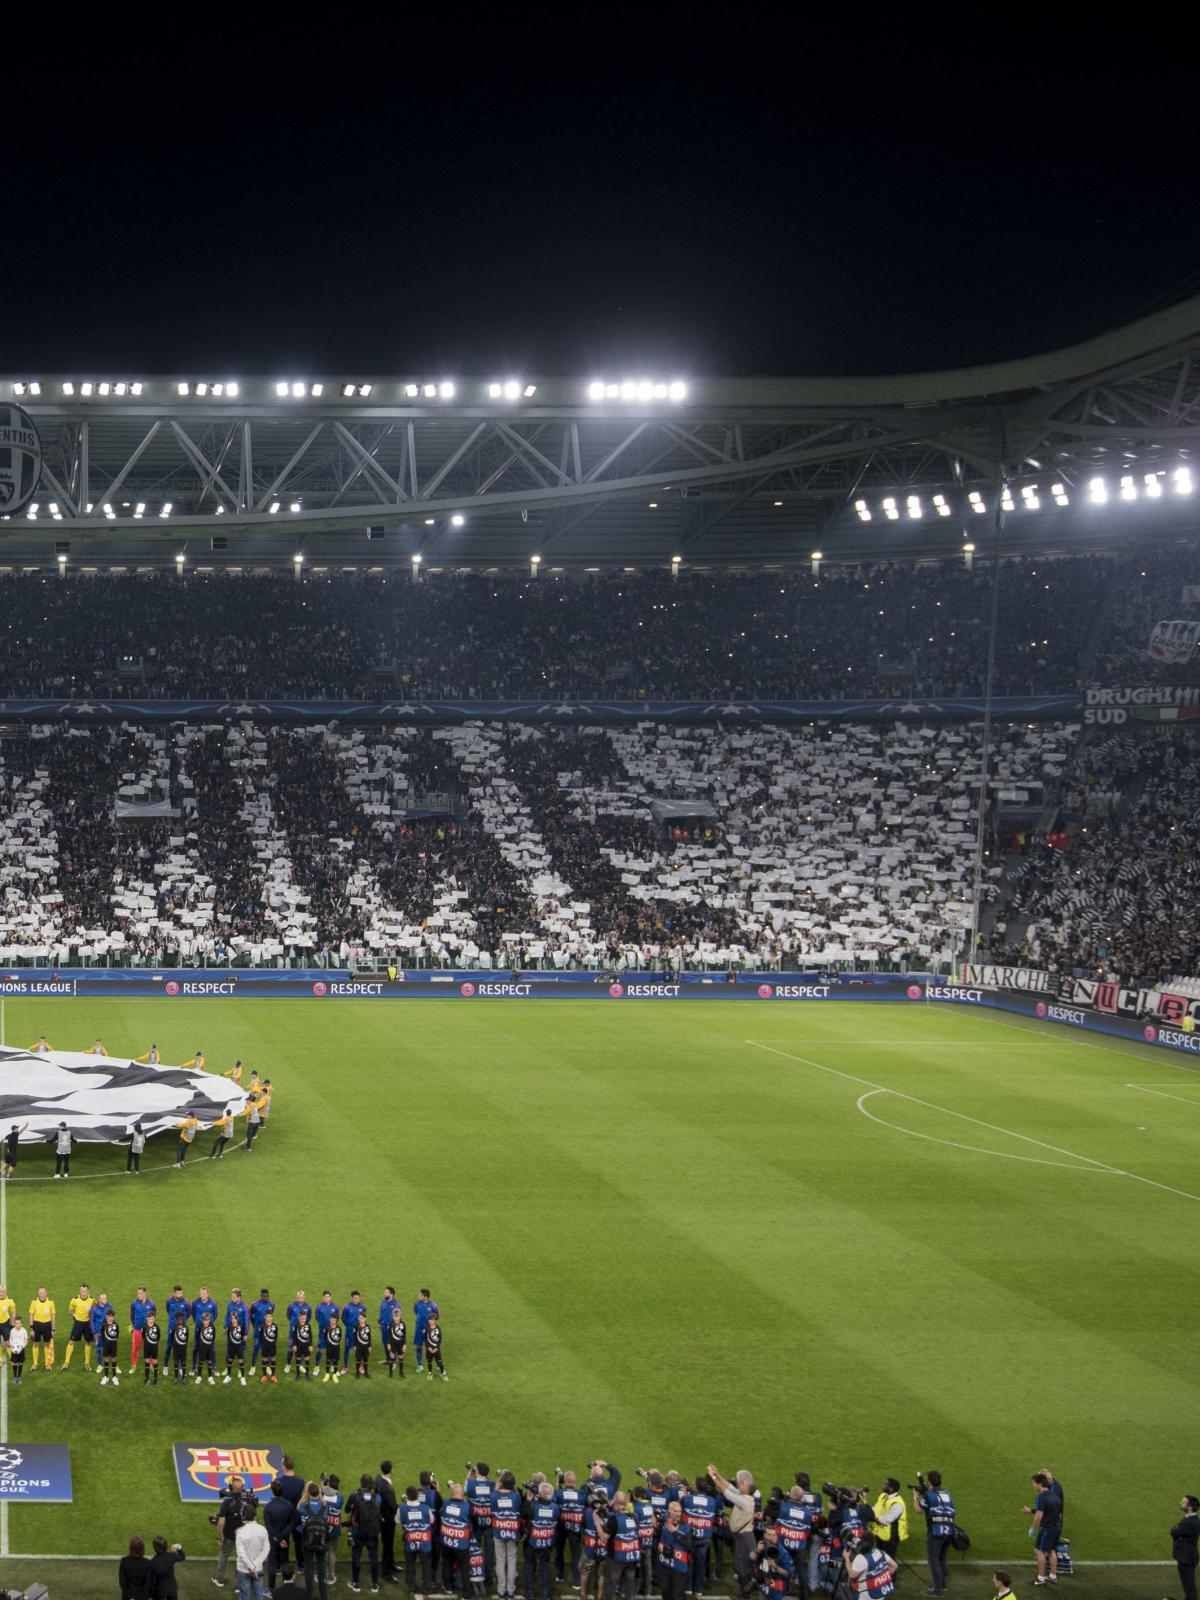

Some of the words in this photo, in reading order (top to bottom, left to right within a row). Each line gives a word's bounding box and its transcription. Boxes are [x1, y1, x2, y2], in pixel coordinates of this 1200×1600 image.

[1083, 709, 1128, 724] SUD
[31, 983, 72, 993] LEAGUE
[183, 982, 235, 994] RESPECT
[330, 983, 383, 994] RESPECT
[478, 984, 532, 995] RESPECT
[627, 984, 680, 996] RESPECT
[775, 985, 830, 997] RESPECT
[926, 986, 983, 1001] RESPECT
[1048, 1005, 1086, 1024] RESPECT
